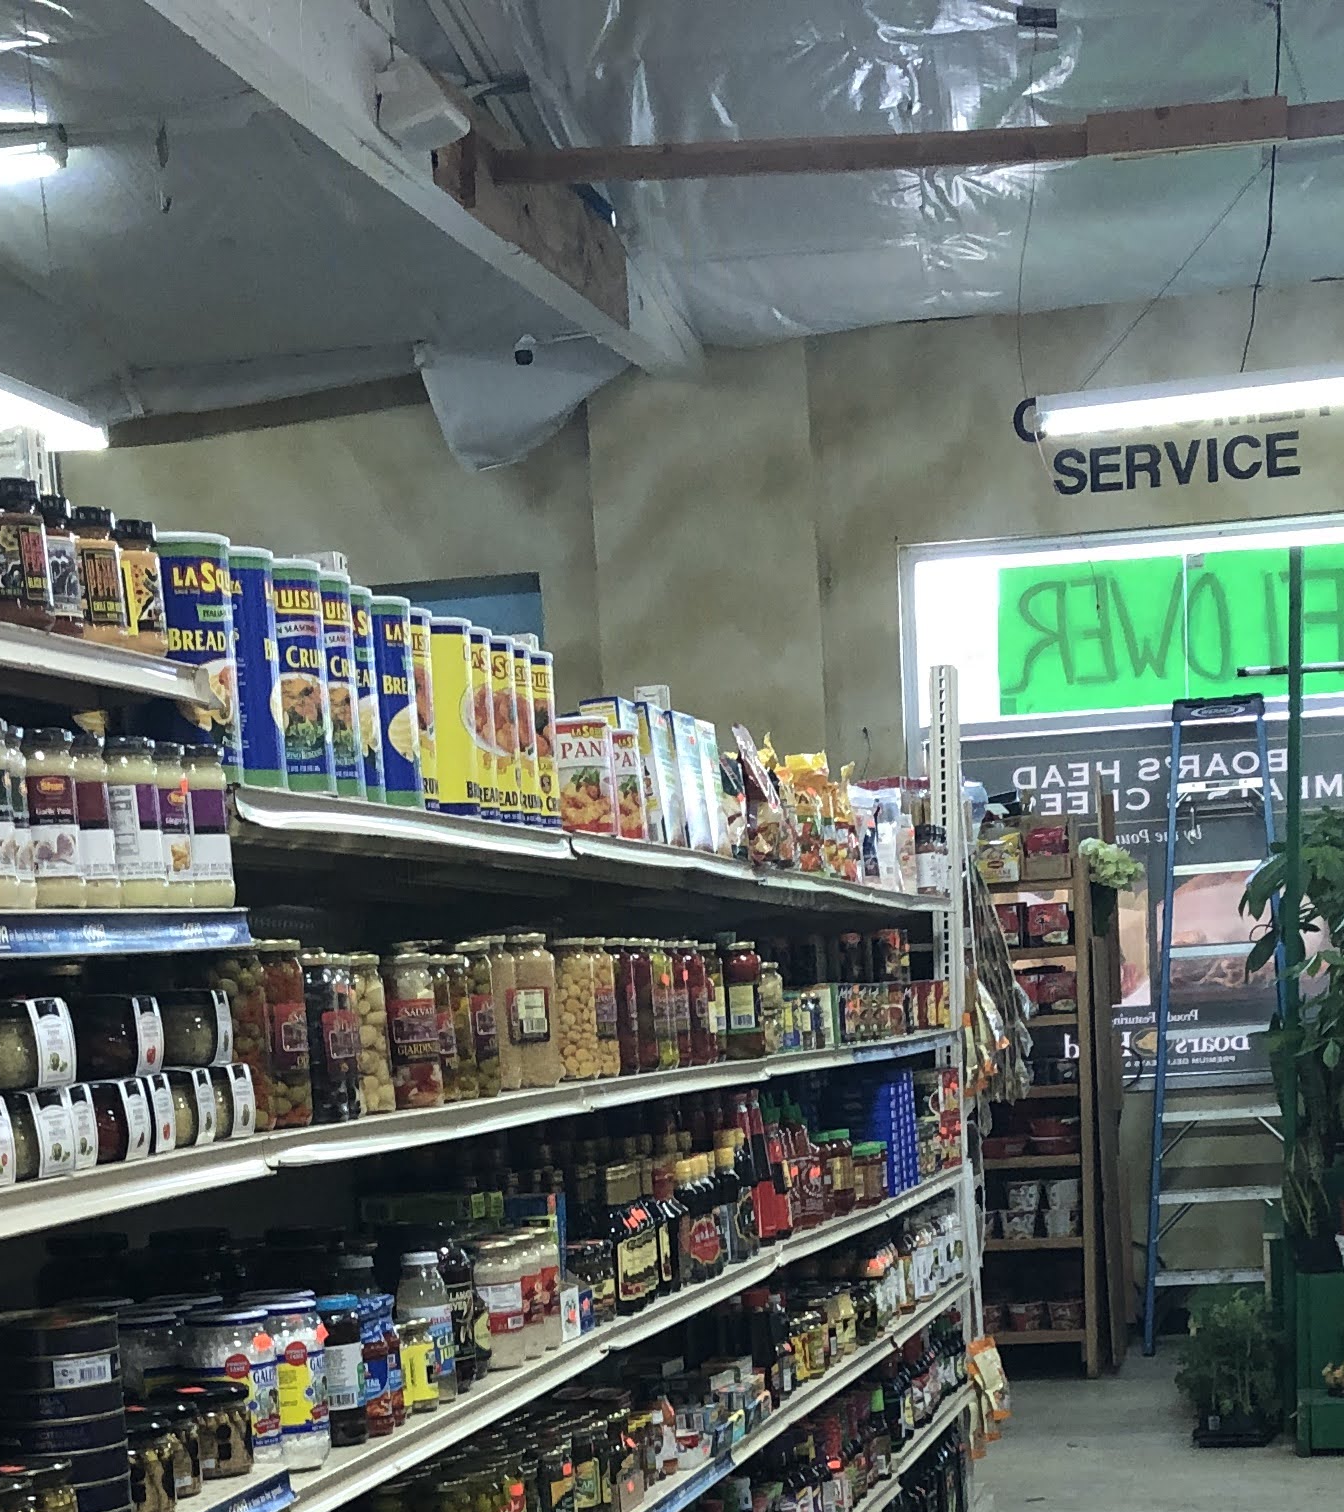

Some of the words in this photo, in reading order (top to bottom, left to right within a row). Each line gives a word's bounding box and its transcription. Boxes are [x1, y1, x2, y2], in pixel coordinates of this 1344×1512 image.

[1054, 431, 1301, 494] SERVICE
[172, 566, 198, 587] LA
[168, 627, 226, 652] BREAD
